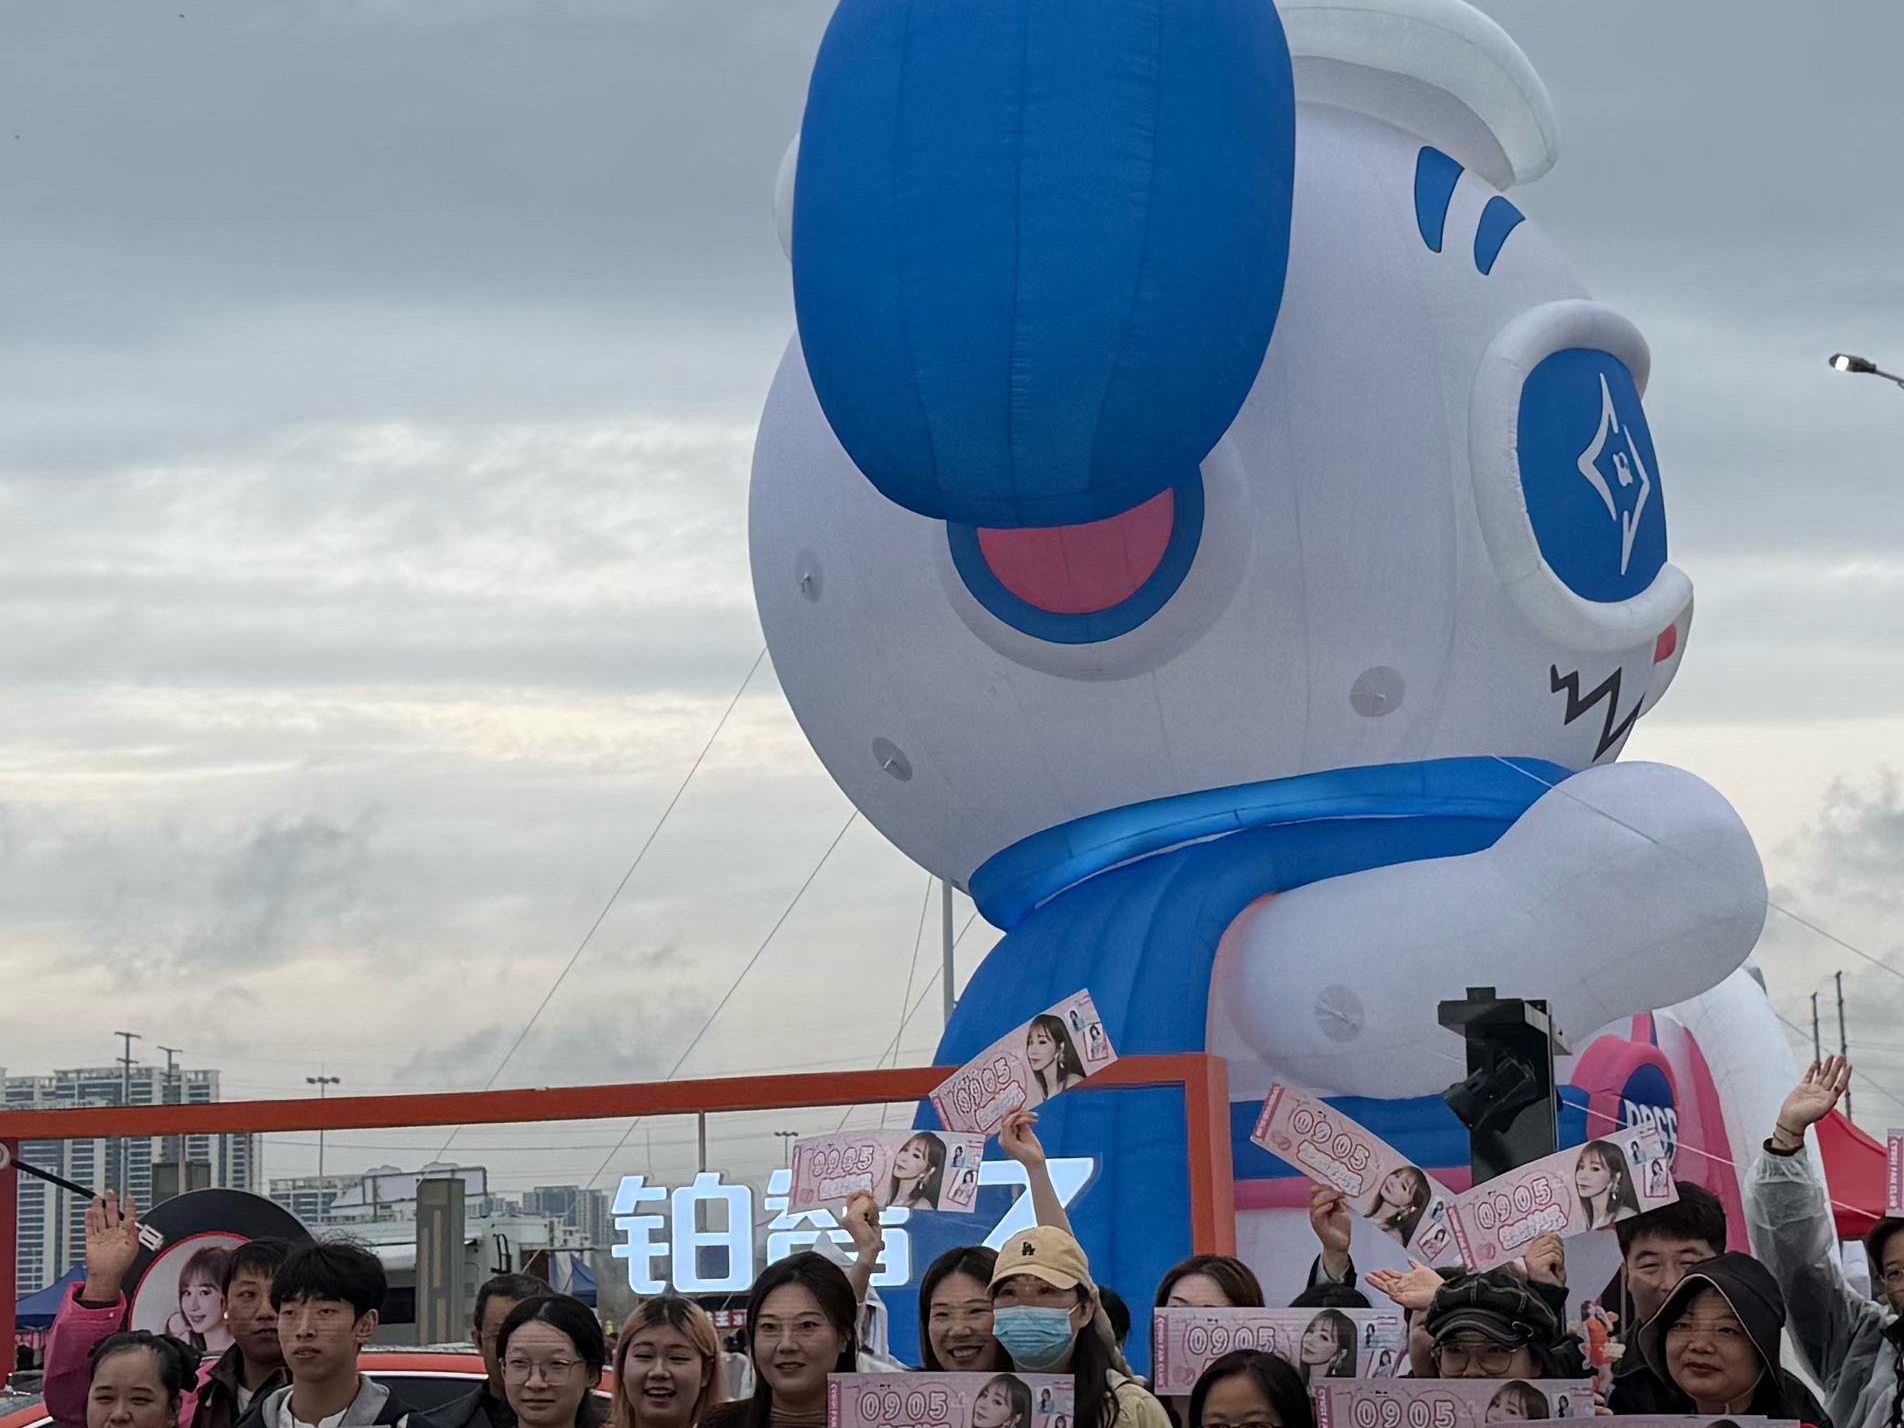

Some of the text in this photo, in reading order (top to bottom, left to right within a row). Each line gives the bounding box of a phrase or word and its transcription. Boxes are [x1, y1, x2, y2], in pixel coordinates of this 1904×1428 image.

[1293, 1109, 1371, 1171] 0905
[1477, 1176, 1553, 1229] 0905
[1188, 1326, 1277, 1356] 0905
[860, 1391, 949, 1421] 0905
